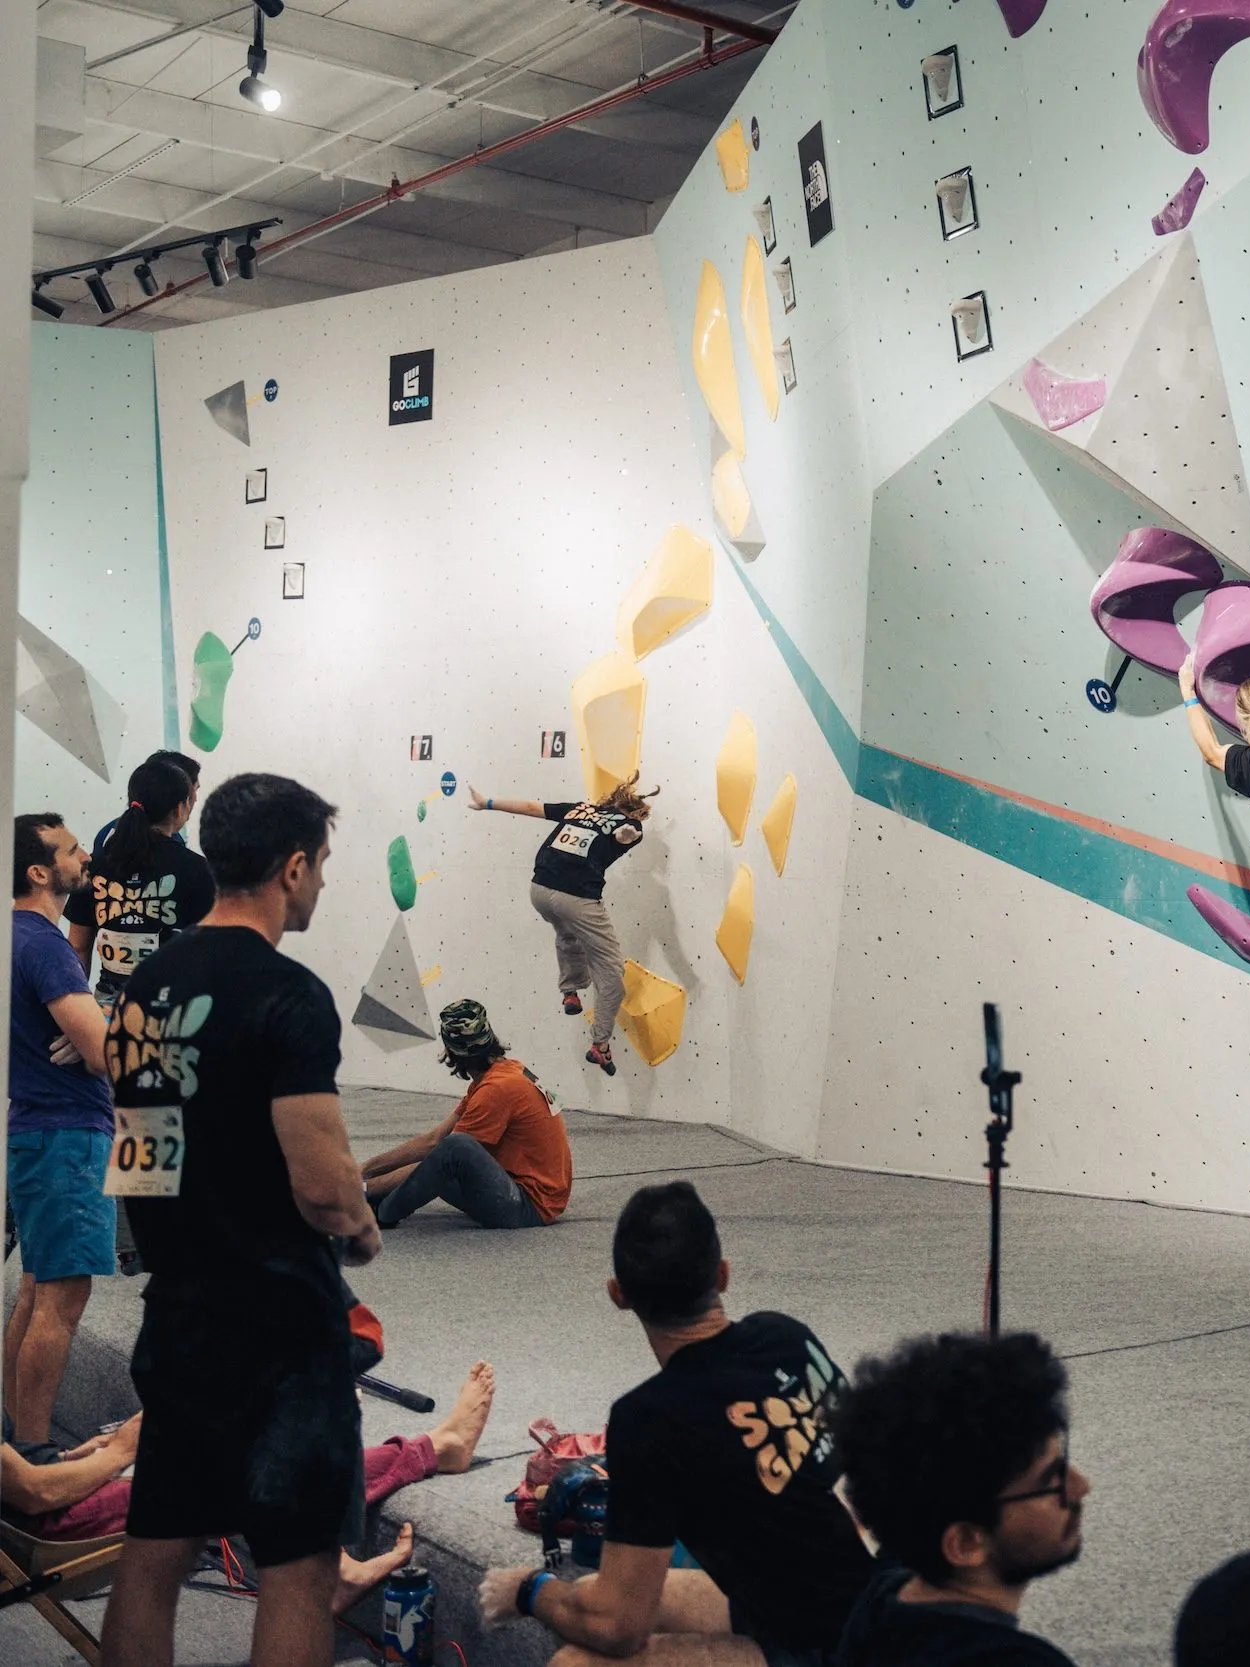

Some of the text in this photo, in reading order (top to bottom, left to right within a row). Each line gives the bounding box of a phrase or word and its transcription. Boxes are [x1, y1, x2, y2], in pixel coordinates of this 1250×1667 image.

[392, 396, 429, 411] GOCLIMB
[250, 623, 260, 634] 10
[1090, 687, 1111, 704] 10
[413, 738, 431, 756] T7
[544, 735, 563, 753] T6
[559, 833, 590, 848] 026
[92, 874, 177, 901] SQUAD
[95, 899, 177, 927] GAMES
[136, 1070, 163, 1088] 202
[117, 1136, 178, 1172] 032
